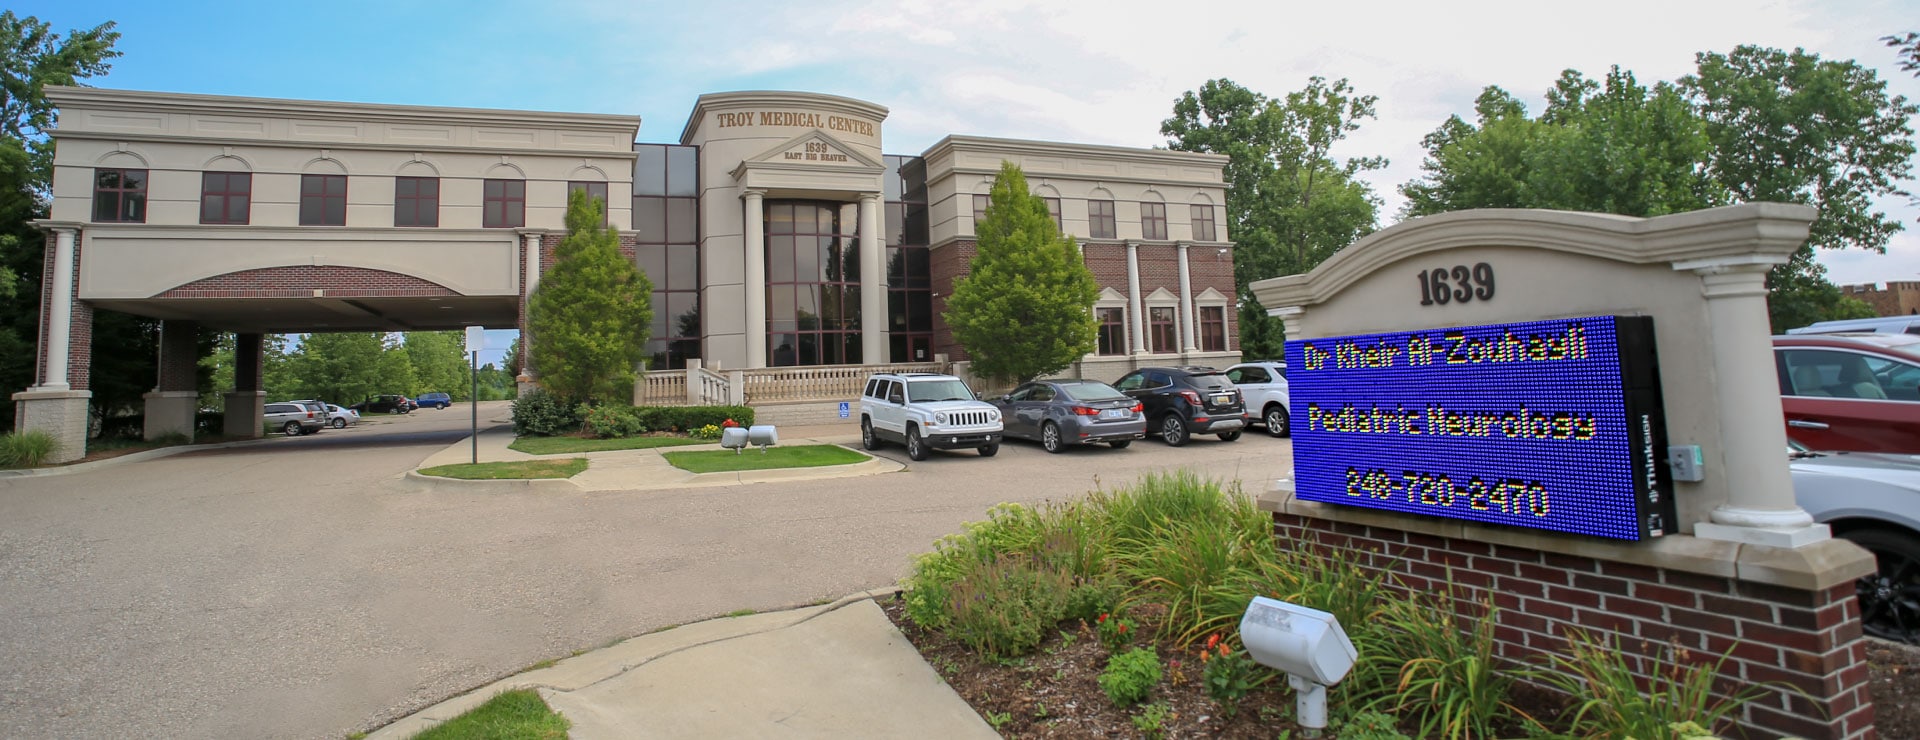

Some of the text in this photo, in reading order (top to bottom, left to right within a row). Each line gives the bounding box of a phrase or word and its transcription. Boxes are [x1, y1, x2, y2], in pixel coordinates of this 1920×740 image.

[717, 111, 874, 137] TROY MEDICAL CENTER
[784, 151, 848, 162] EAST BIG BEAVER
[805, 142, 828, 153] 1639
[1417, 262, 1496, 306] 1639
[1303, 327, 1588, 371] Dr Kheir Al-Zouhayli
[1308, 406, 1598, 441] Pediatric Neurology
[1347, 470, 1551, 518] 248-720-2470
